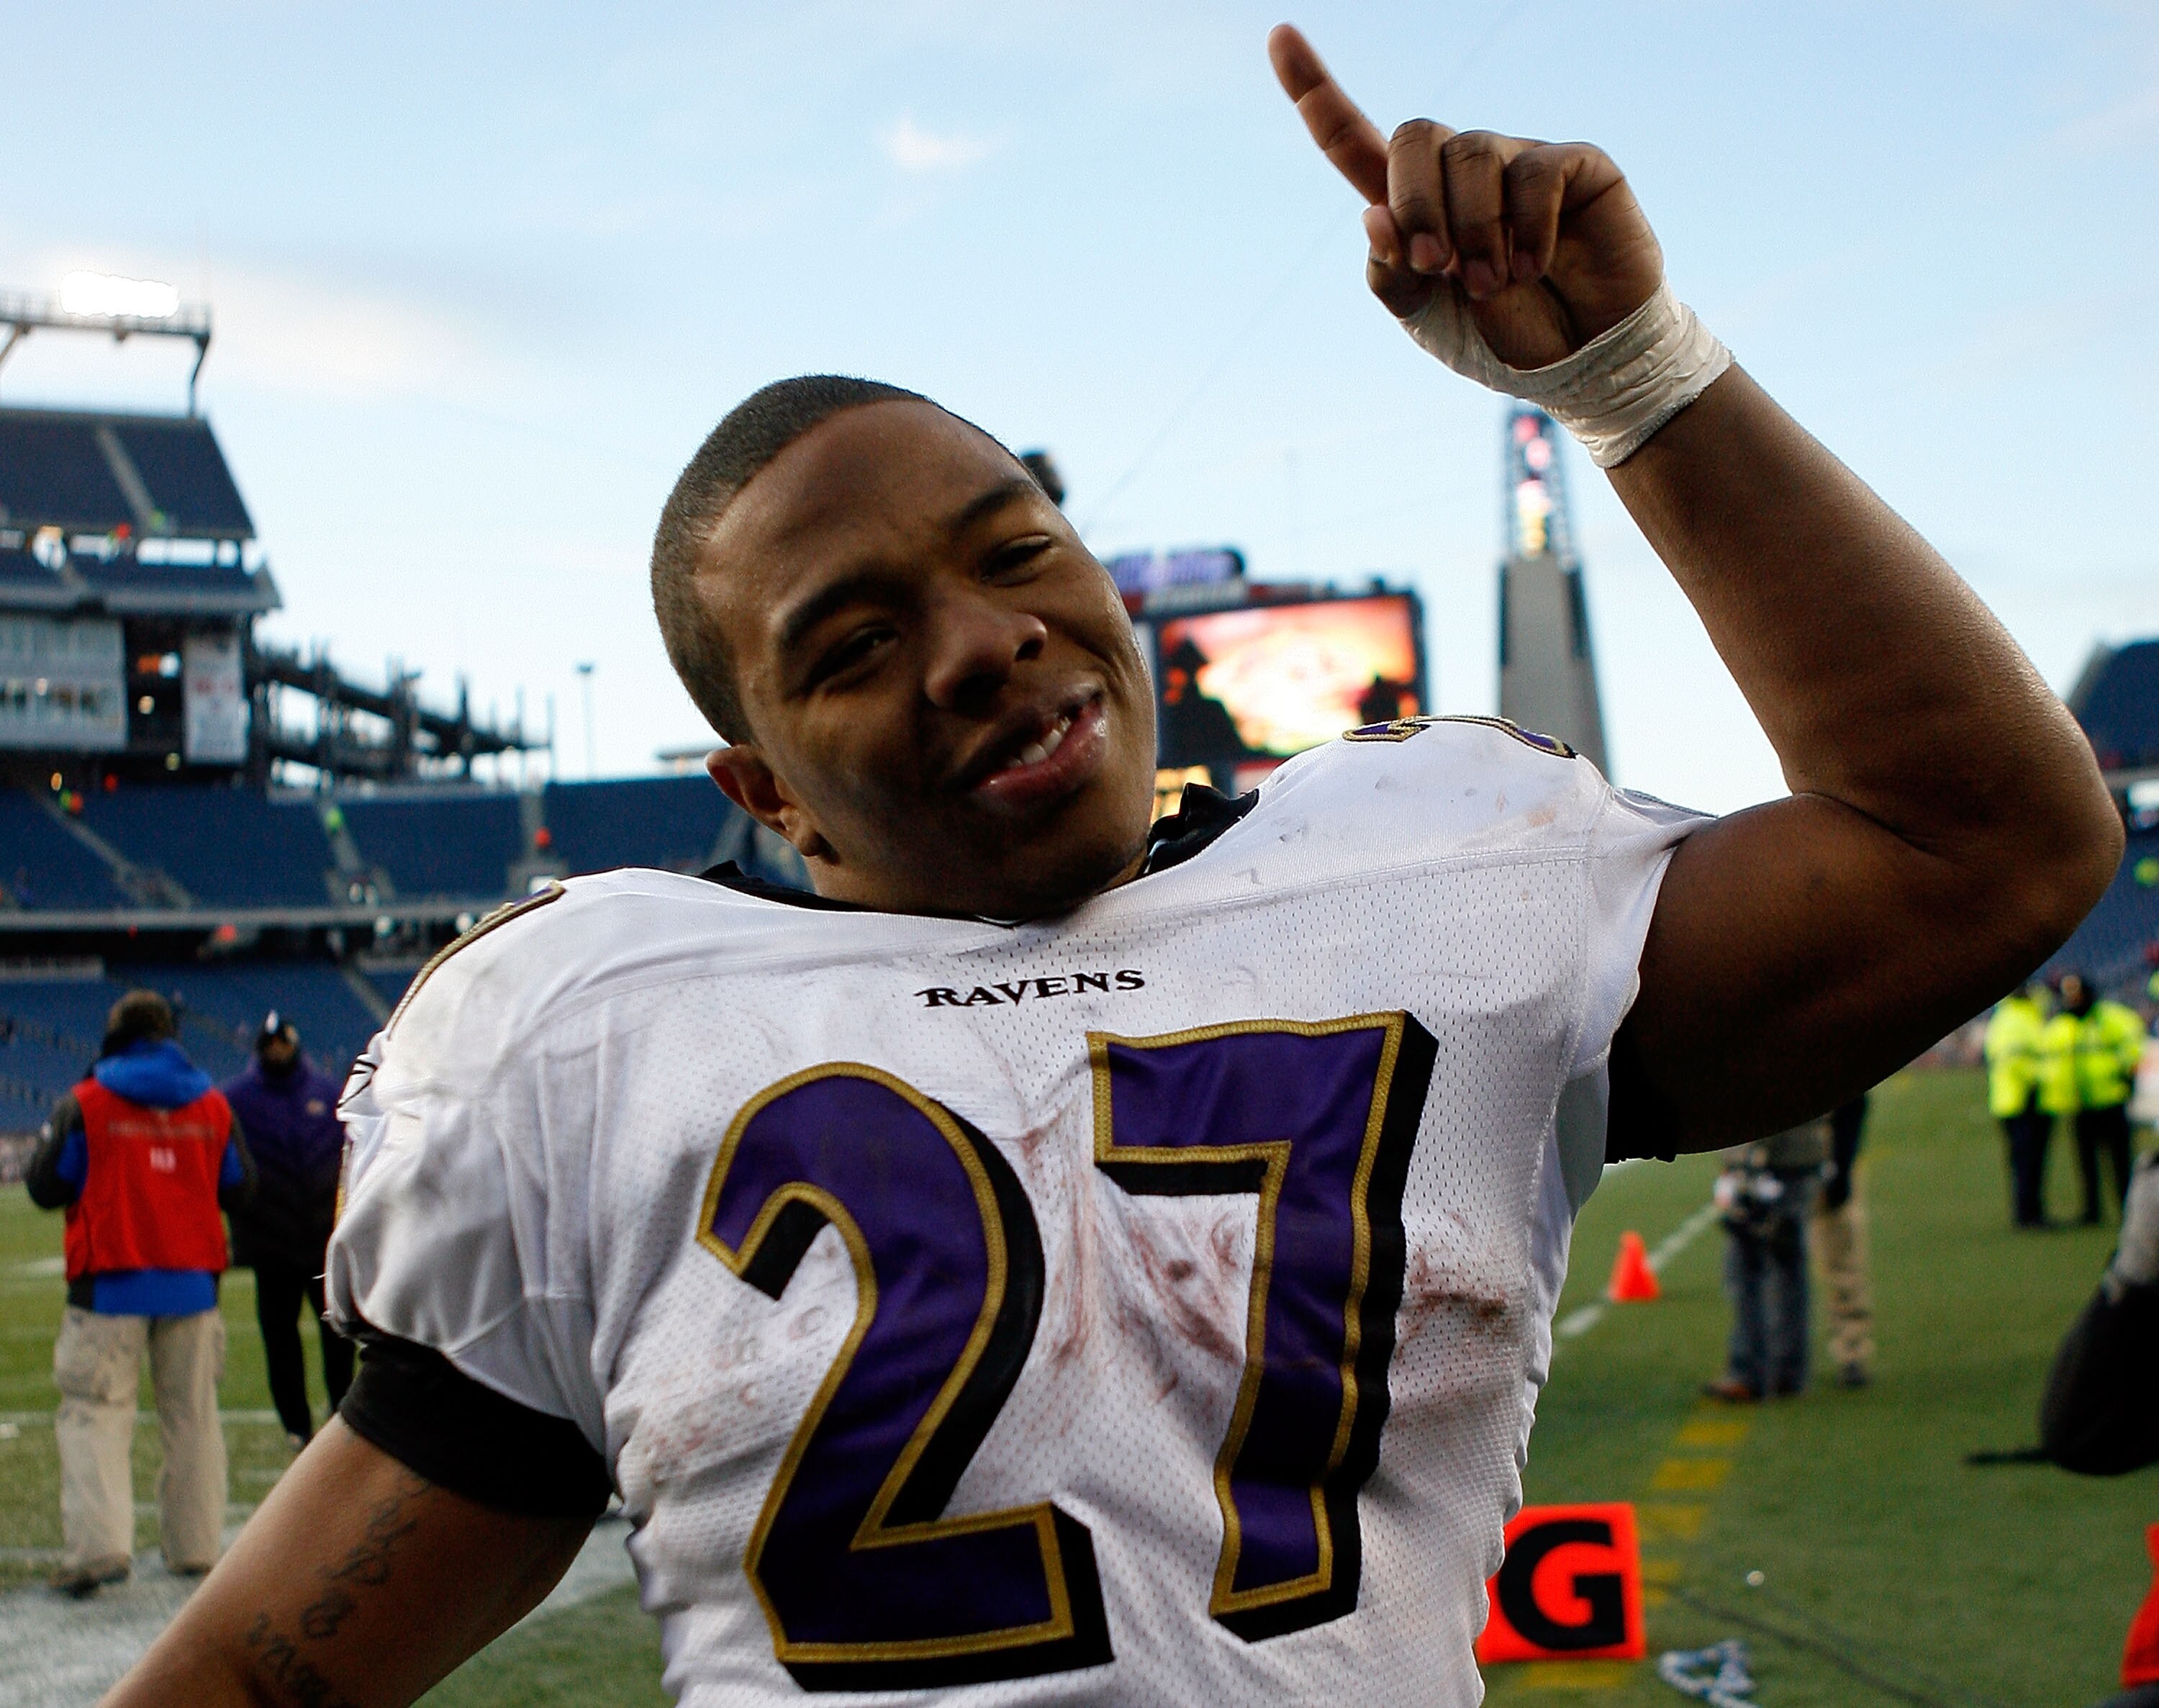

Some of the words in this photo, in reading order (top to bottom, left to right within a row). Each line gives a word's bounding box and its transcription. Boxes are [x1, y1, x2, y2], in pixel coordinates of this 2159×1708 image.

[913, 970, 1145, 1007] RAVENS
[696, 1009, 1439, 1691] 27
[1498, 1519, 1626, 1651] G
